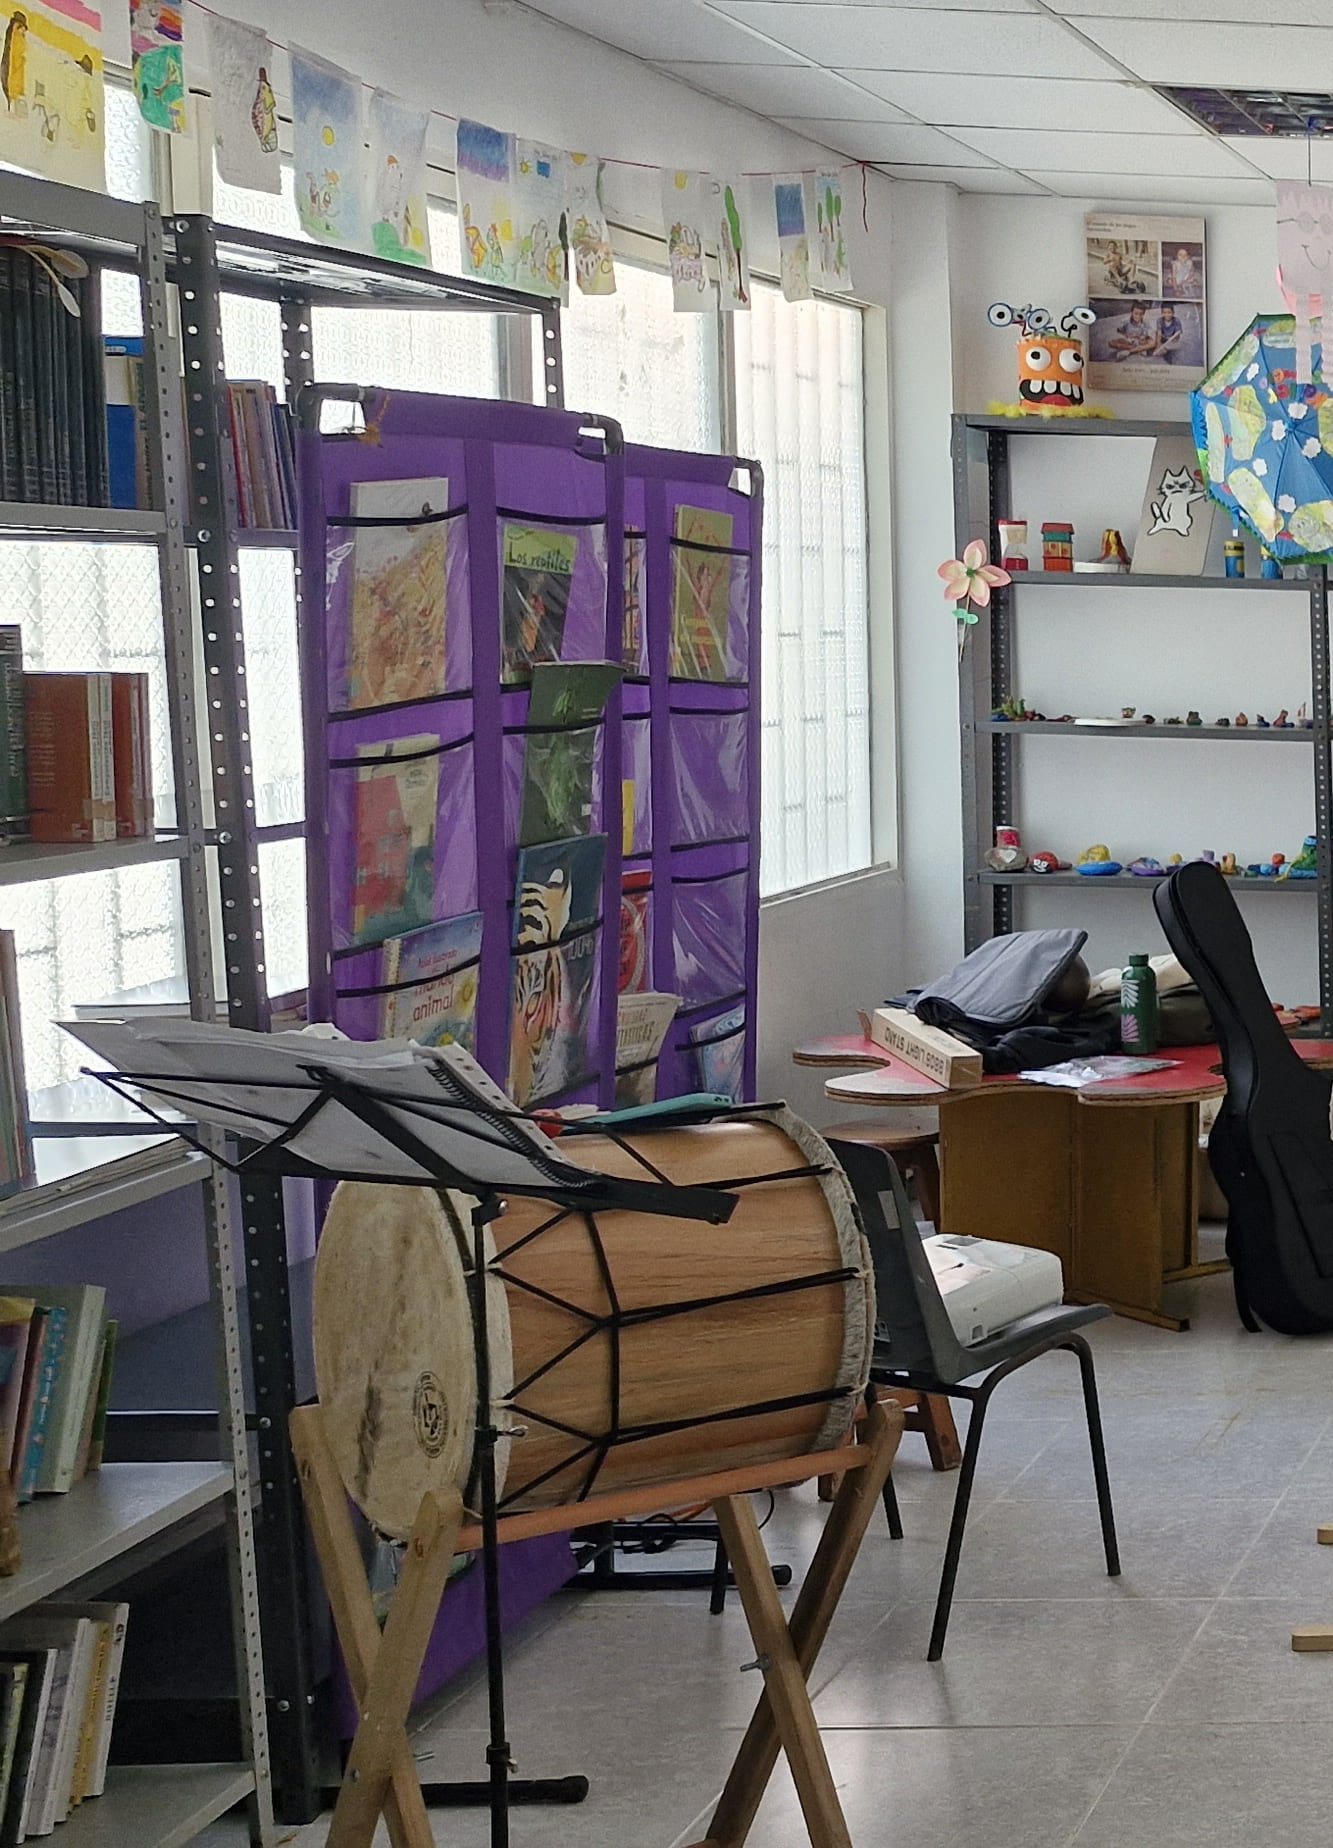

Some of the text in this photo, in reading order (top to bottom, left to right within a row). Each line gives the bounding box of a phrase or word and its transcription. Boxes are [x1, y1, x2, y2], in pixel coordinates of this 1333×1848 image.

[508, 541, 571, 572] Los reptiles
[412, 984, 454, 1022] animal
[884, 1026, 905, 1052] STAND
